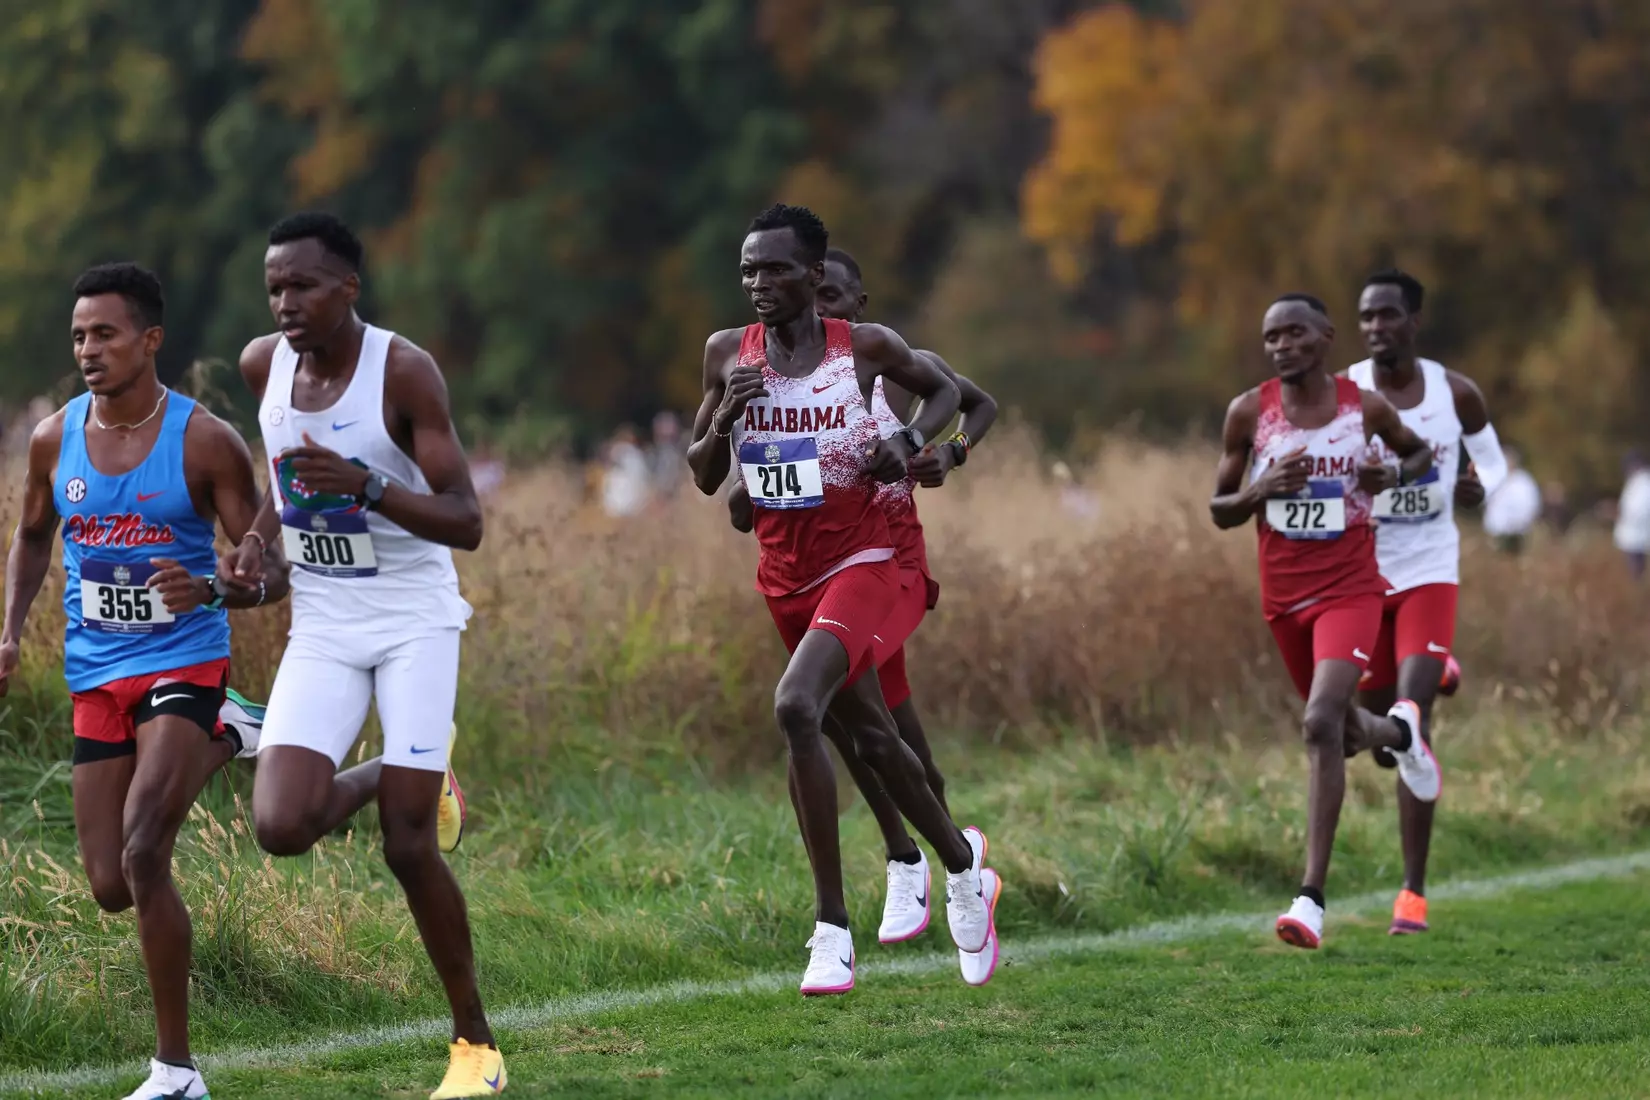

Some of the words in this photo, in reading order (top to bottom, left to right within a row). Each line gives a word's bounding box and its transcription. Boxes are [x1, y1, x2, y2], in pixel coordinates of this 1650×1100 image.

[744, 405, 846, 433] ALABAMA
[66, 478, 86, 503] SEC
[757, 463, 802, 498] 274
[1285, 502, 1326, 529] 272
[1390, 488, 1430, 514] 285
[68, 513, 107, 546] Ole
[104, 512, 176, 548] Miss
[299, 531, 355, 566] 300
[98, 586, 153, 622] 355
